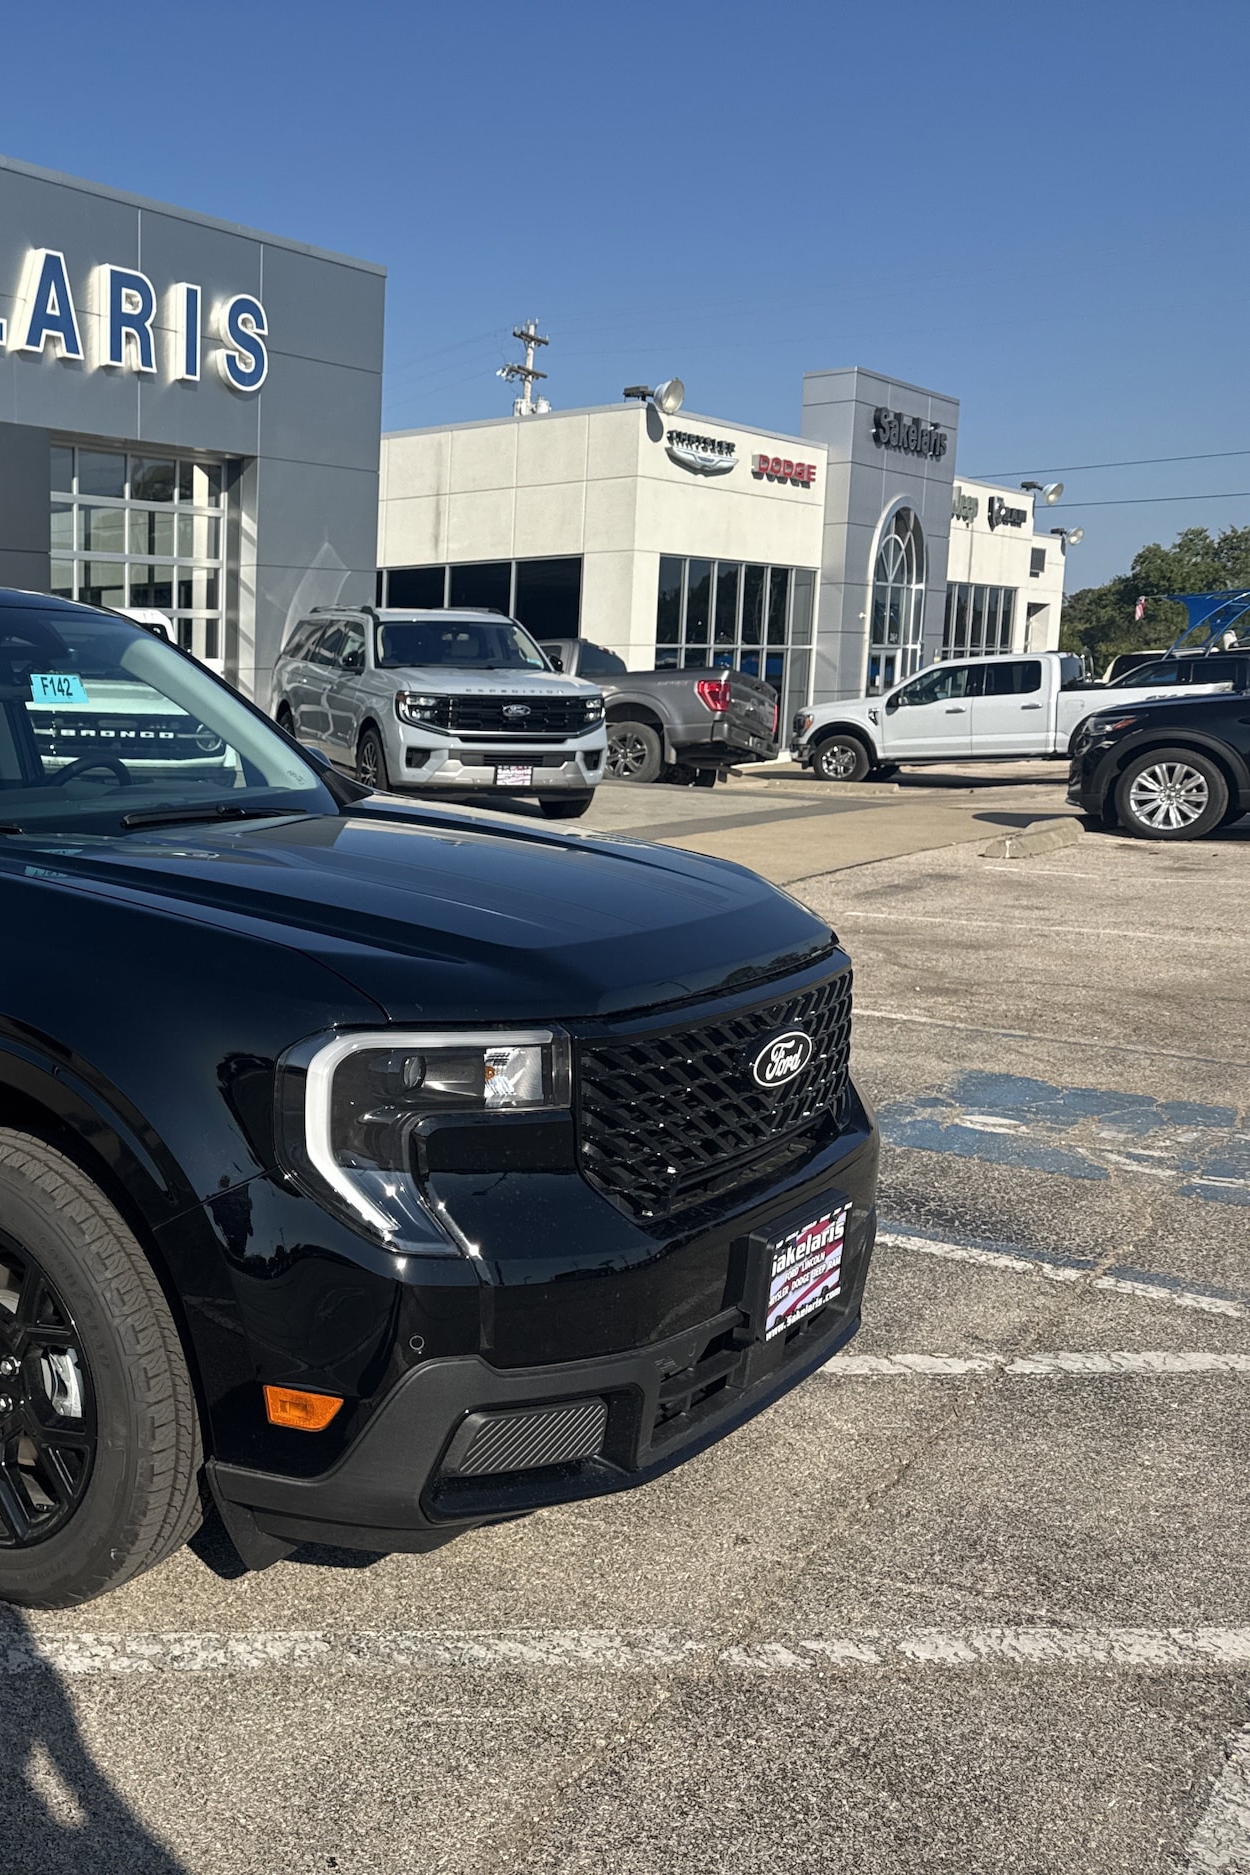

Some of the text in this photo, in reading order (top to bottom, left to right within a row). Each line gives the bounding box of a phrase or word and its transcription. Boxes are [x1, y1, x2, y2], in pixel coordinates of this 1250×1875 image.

[667, 429, 736, 453] CHRYSLER
[874, 407, 947, 456] Sakelaris
[753, 454, 816, 482] DODGE
[41, 676, 73, 697] F142
[61, 729, 174, 739] BRONCO
[765, 1039, 803, 1081] Ford
[785, 1251, 826, 1282] FORD LINCOLN
[791, 1271, 811, 1292] DODGE
[828, 1255, 842, 1271] RAM
[765, 1286, 842, 1341] www.Sakelaris.com
